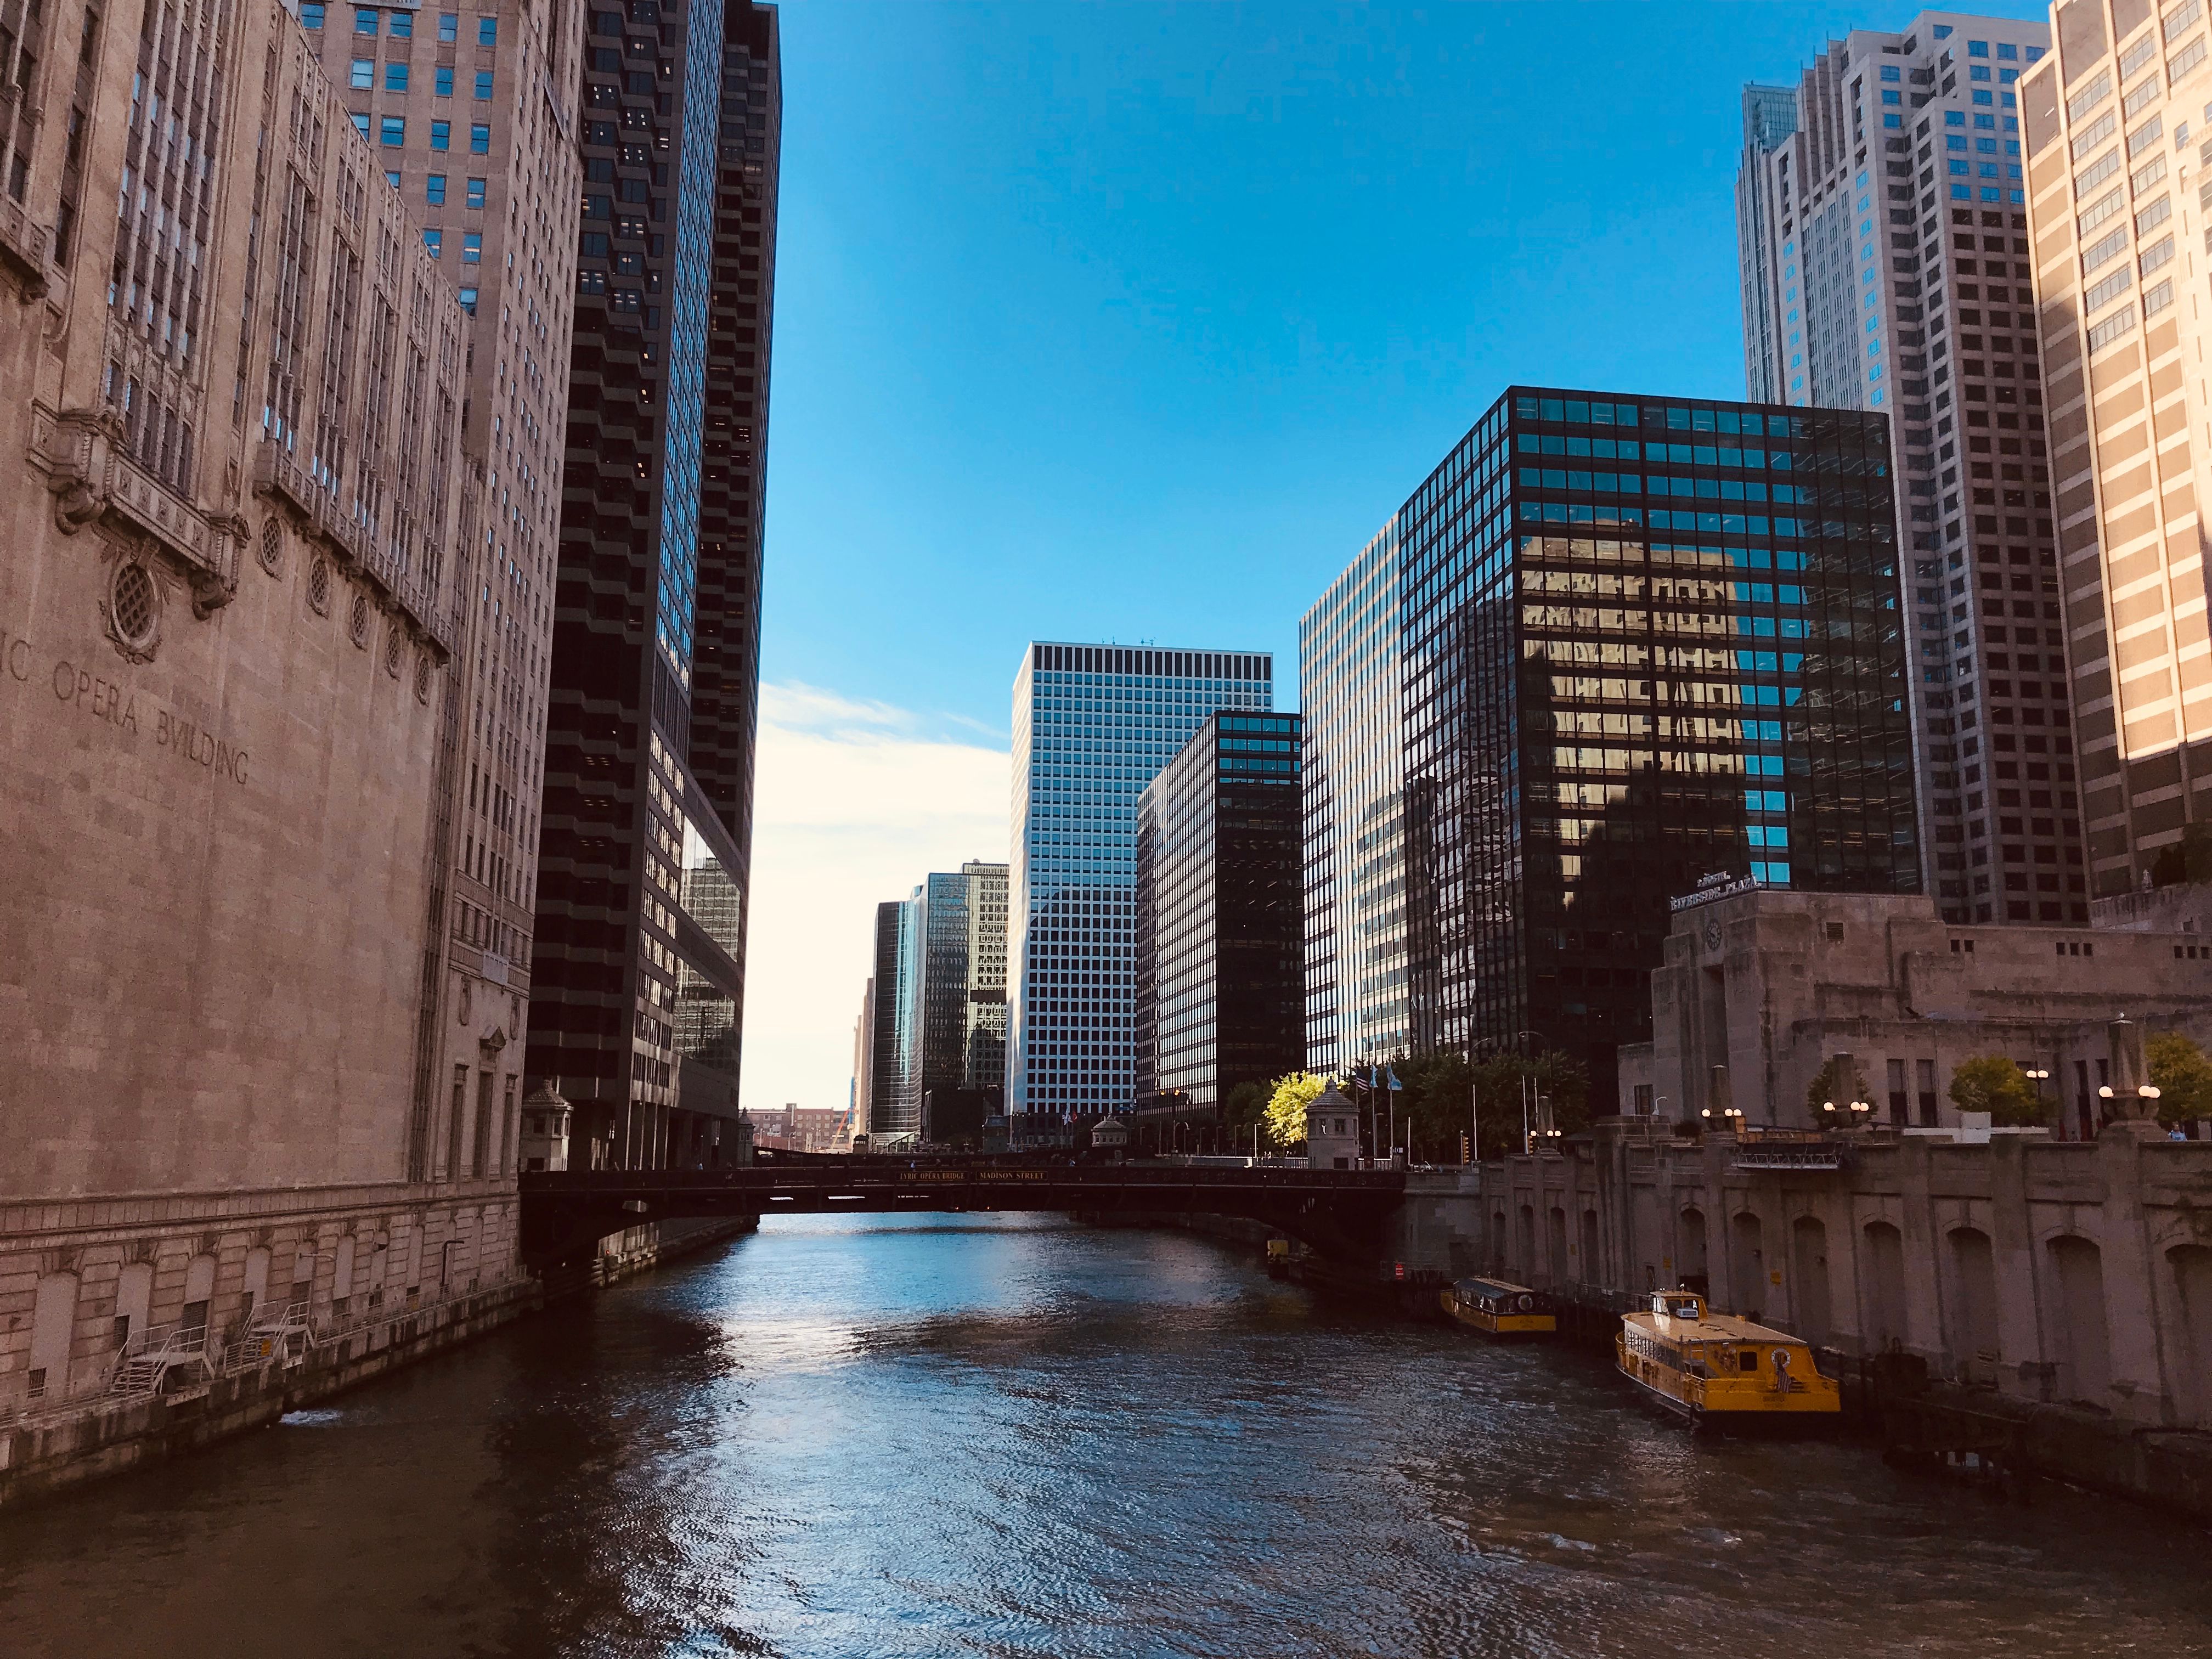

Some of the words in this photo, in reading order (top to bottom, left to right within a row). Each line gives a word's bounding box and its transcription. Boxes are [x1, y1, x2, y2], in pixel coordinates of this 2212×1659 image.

[54, 661, 137, 733] OPERA
[1670, 886, 1720, 910] RIVERSIDE
[1725, 876, 1758, 895] PLAZA
